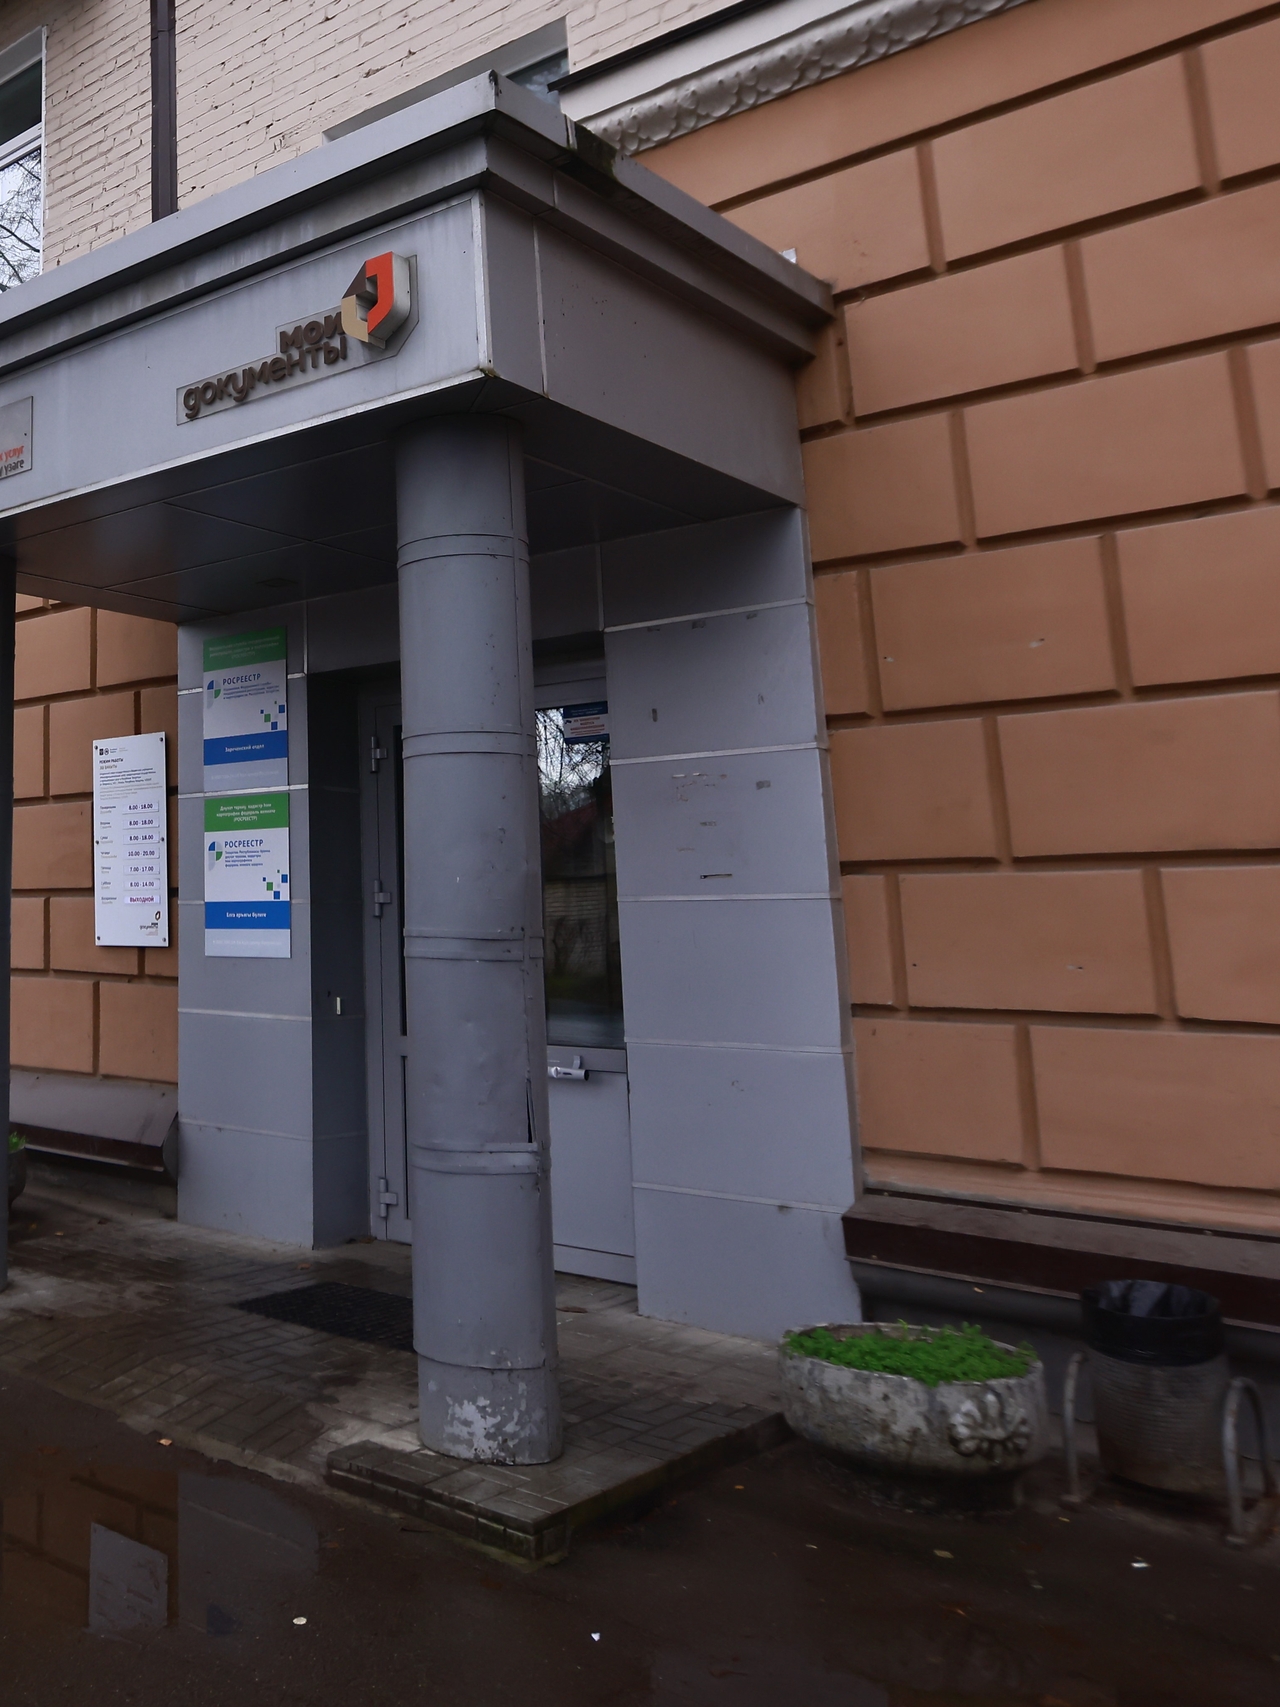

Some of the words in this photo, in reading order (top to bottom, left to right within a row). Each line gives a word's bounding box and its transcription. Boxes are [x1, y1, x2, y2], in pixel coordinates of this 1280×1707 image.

[279, 311, 345, 354] мои
[183, 335, 348, 419] документы
[3, 445, 24, 463] услуг
[223, 673, 261, 686] РОСРЕЕСТР
[224, 839, 264, 848] РОСРЕЕСТР
